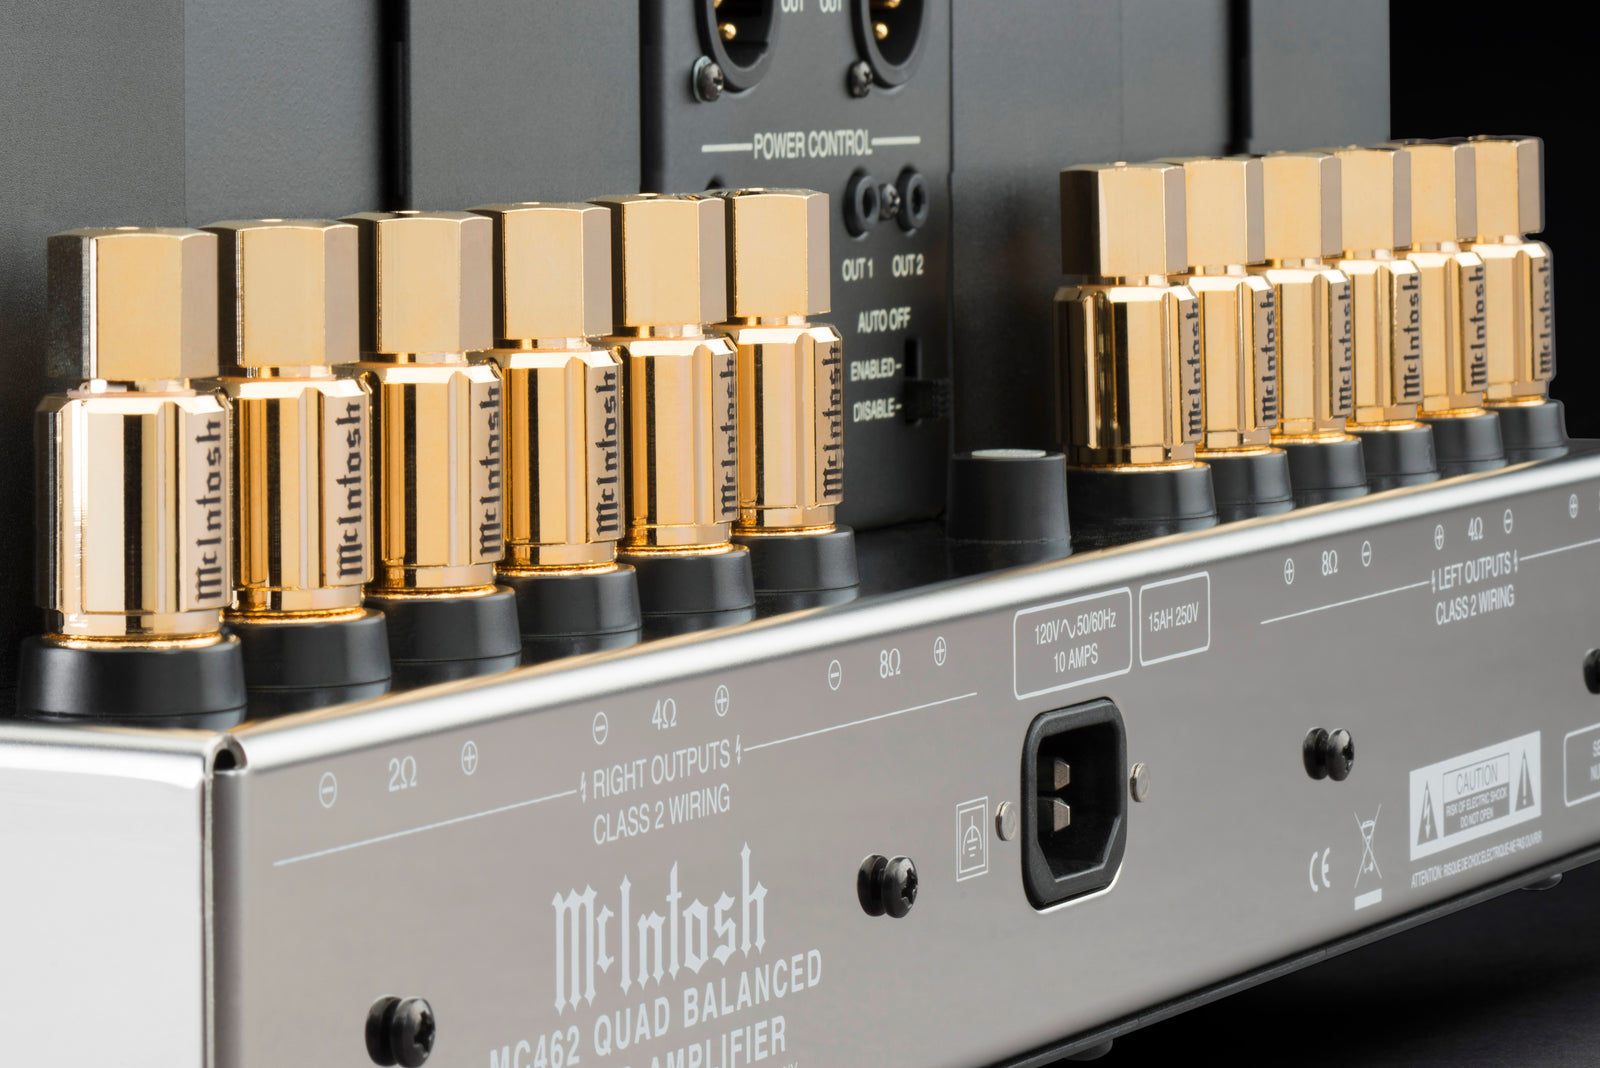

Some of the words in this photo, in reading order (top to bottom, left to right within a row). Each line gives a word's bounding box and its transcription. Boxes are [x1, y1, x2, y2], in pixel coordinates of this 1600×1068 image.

[753, 133, 805, 161] POWER
[807, 129, 873, 157] CONTROL
[842, 257, 866, 282] OUT
[867, 258, 873, 279] 1
[892, 254, 915, 278] OUT
[916, 253, 924, 276] 2
[857, 308, 888, 334] AUTO
[889, 306, 911, 331] OFF
[1402, 274, 1420, 398] McIntosh
[1469, 267, 1487, 386] McIntosh
[850, 357, 895, 382] ENABLED
[1260, 291, 1277, 422] McIntosh
[822, 345, 843, 498] McIntosh
[853, 397, 896, 423] DISABLE
[479, 386, 500, 557] McIntosh
[595, 371, 618, 535] McIntosh
[336, 401, 363, 579] McIntosh
[195, 419, 223, 603] McIntosh
[1468, 516, 1483, 541] 4Ω
[1321, 549, 1338, 576] 8Ω
[1439, 562, 1464, 590] LEFT
[1465, 551, 1512, 584] OUTPUTS
[1149, 608, 1174, 633] 15AH
[1175, 601, 1199, 627] 250V
[1435, 596, 1469, 625] CLASS
[1470, 595, 1477, 617] 2
[1479, 583, 1515, 614] WIRING
[879, 647, 902, 679] 8Ω
[1054, 652, 1066, 673] 10
[1068, 642, 1099, 671] AMPS
[652, 698, 677, 730] 4Ω
[388, 755, 418, 792] 2Ω
[593, 757, 647, 800] RIGHT
[650, 739, 731, 785] OUTPUTS
[1456, 761, 1498, 795] CAUTION
[593, 804, 650, 845] CLASS
[654, 801, 665, 830] 2
[669, 783, 731, 826] WIRING
[552, 841, 768, 1016] McIntosh
[593, 997, 670, 1056] QUAD
[683, 948, 822, 1028] BALANCED
